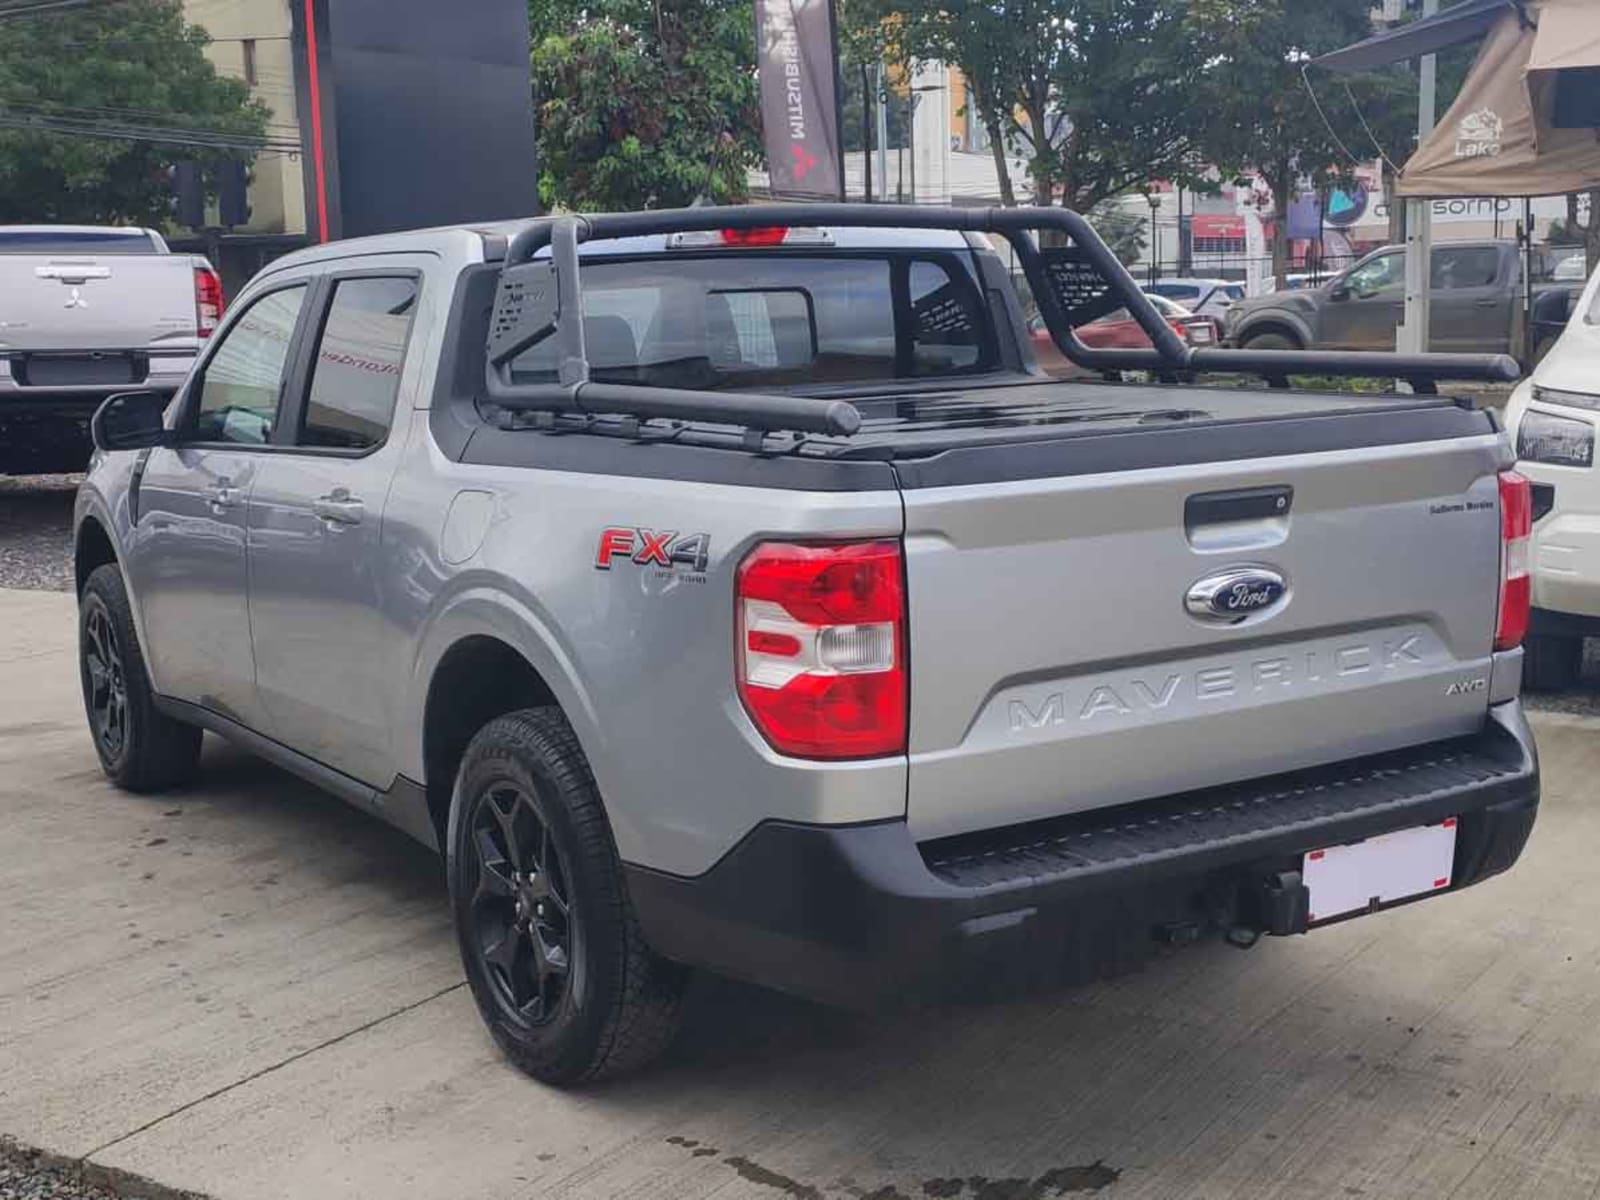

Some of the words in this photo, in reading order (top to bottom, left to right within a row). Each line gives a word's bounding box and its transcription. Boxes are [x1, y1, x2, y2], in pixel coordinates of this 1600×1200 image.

[595, 526, 711, 572] FX4
[1228, 583, 1271, 608] Ford
[1007, 630, 1424, 731] MAVERICK
[1445, 679, 1487, 696] AWD
